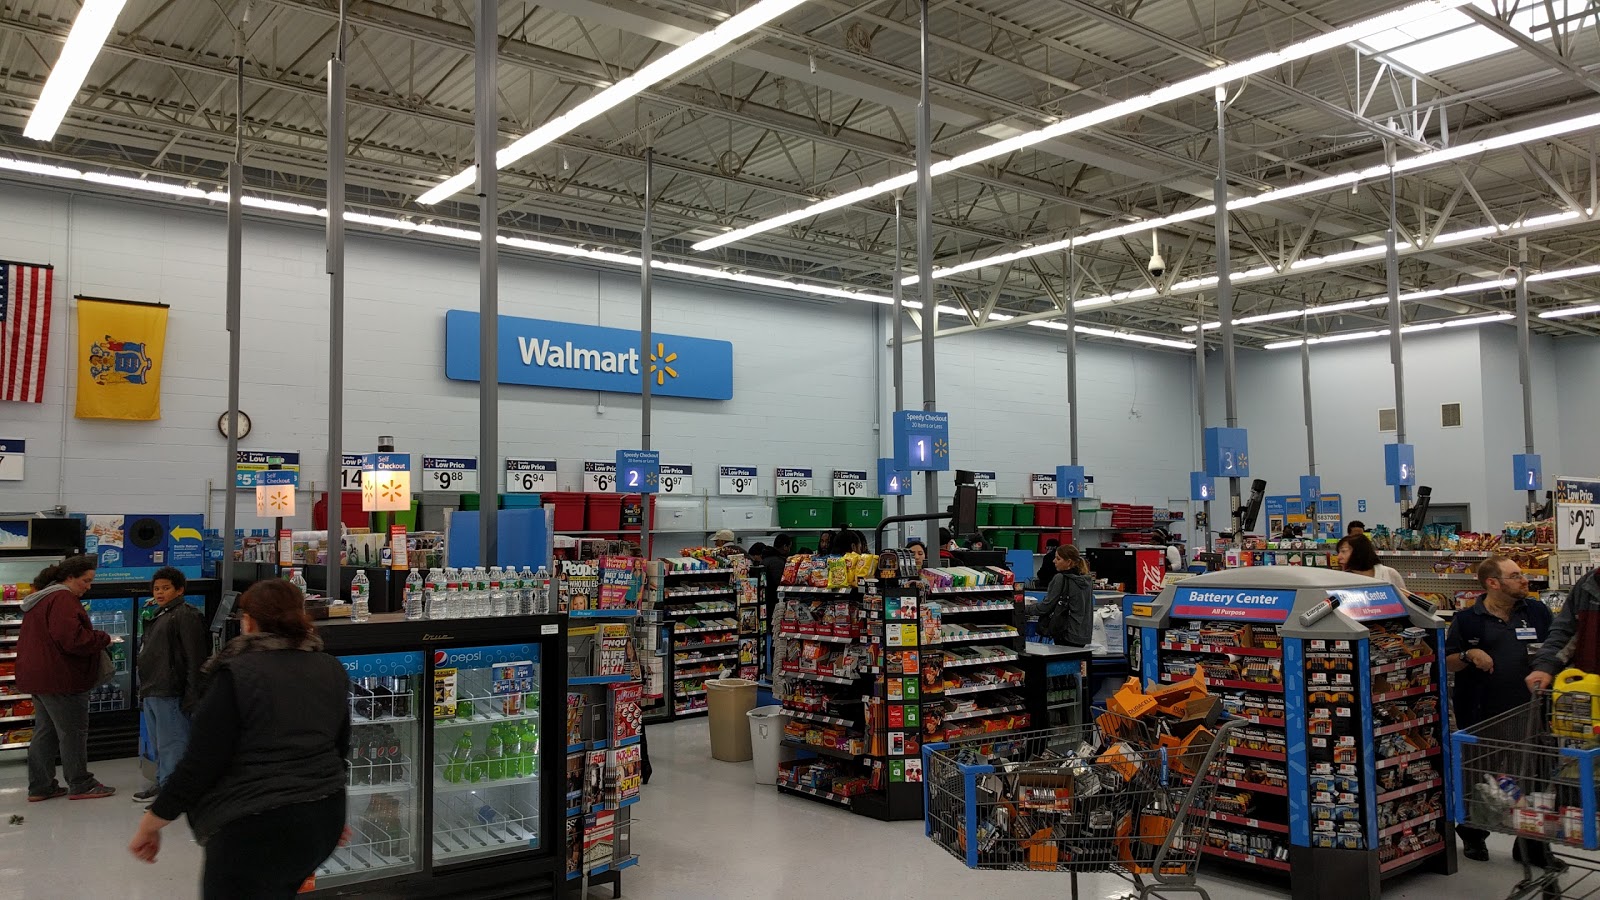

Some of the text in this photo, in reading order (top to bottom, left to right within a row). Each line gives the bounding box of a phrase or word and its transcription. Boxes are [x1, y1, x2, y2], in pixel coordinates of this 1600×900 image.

[518, 336, 638, 375] Walmart
[906, 413, 924, 422] Speedy
[918, 440, 925, 462] 1
[1225, 452, 1232, 469] 3
[629, 470, 638, 486] 2
[1402, 464, 1407, 480] 5
[1528, 471, 1534, 485] 7
[434, 472, 463, 489] $988
[515, 474, 544, 490] $694
[661, 477, 682, 492] $997
[732, 478, 752, 492] $997
[890, 476, 898, 490] 4
[1068, 481, 1074, 493] 6
[1202, 486, 1207, 497] 8
[1309, 488, 1315, 498] 10
[1567, 490, 1593, 501] Low Price
[1570, 510, 1594, 545] $250
[1189, 591, 1278, 605] Battery Center
[1365, 590, 1388, 601] Center
[1306, 603, 1326, 617] Energizer
[450, 651, 482, 664] pepsi
[602, 651, 625, 659] WIFE
[342, 660, 359, 671] psi
[434, 706, 440, 716] 2
[1128, 698, 1153, 714] DURACELL
